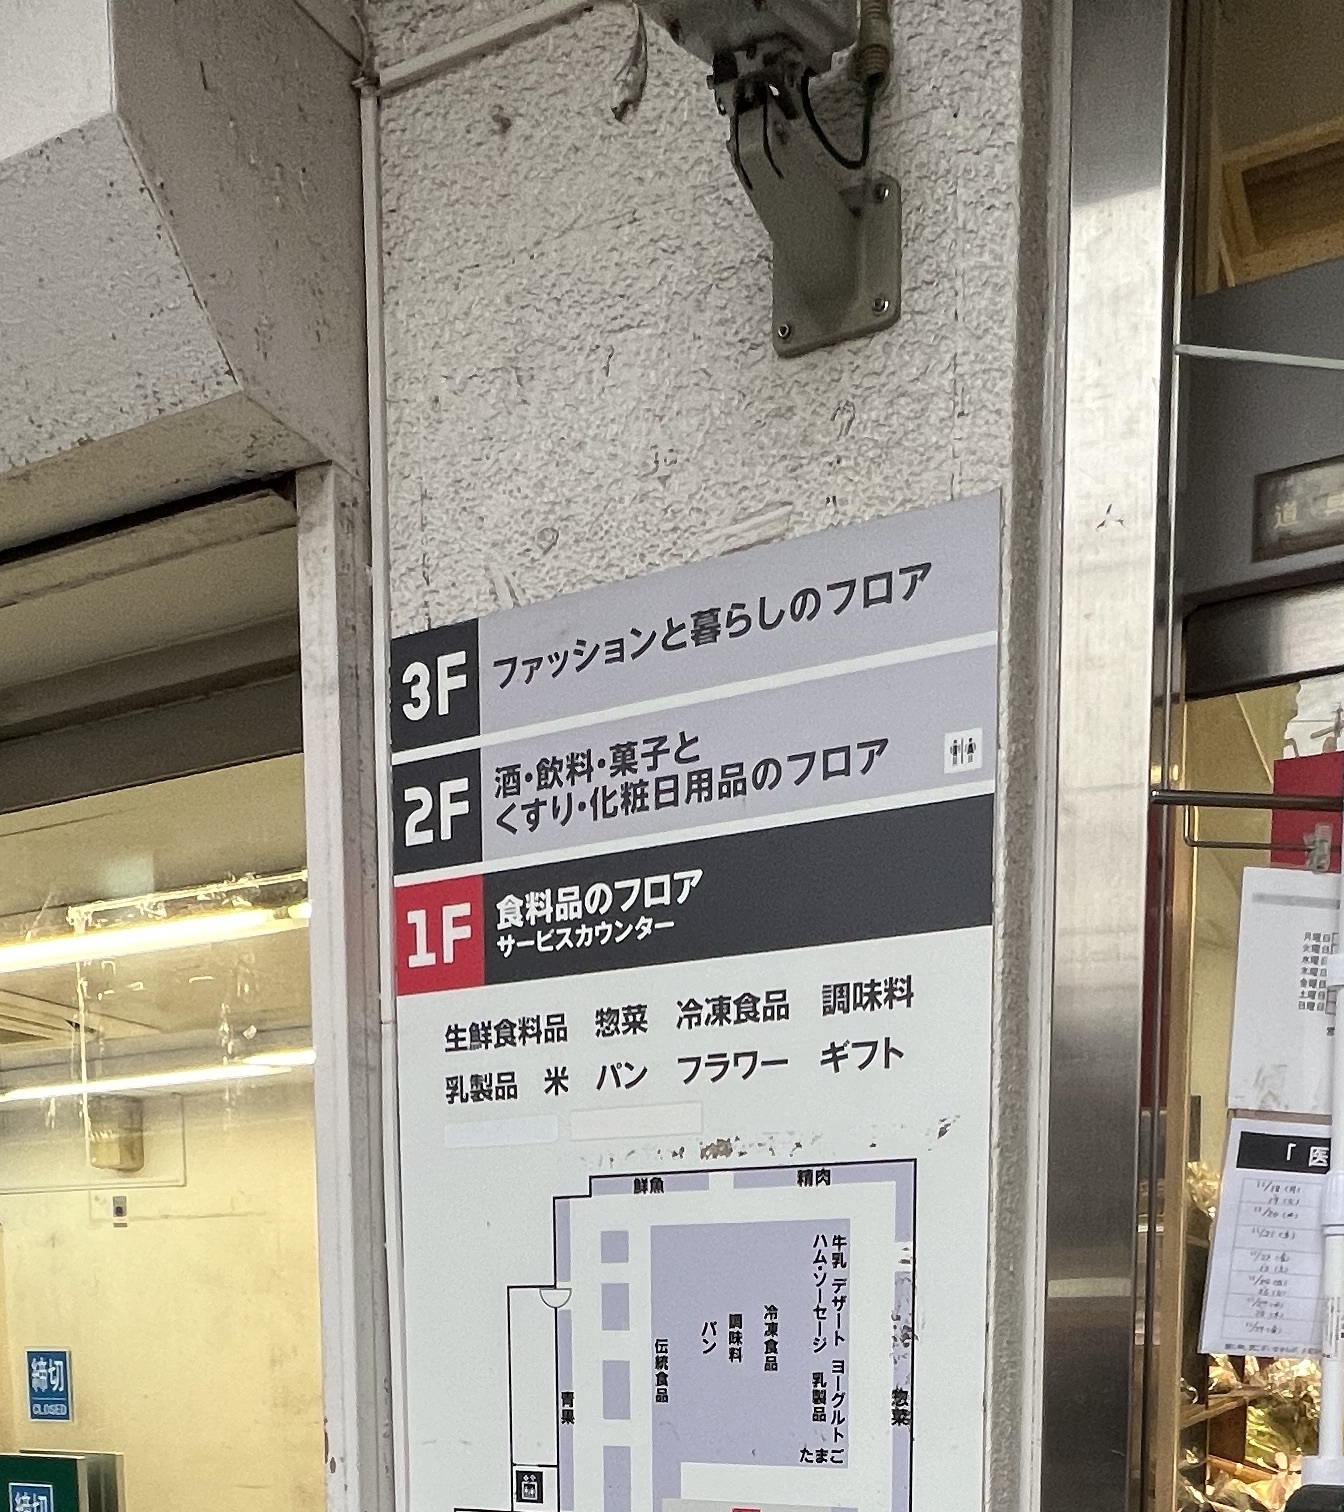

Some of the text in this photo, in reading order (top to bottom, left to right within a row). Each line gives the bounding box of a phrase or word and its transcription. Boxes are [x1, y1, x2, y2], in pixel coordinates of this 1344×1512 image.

[493, 562, 933, 690] ファッションと暮らしのフロア
[401, 650, 467, 723] 3F
[494, 731, 701, 800] 酒・飲料・菓子と
[495, 737, 889, 838] くすり・化粧日用品のフロア
[403, 777, 471, 848] 2F
[495, 868, 704, 932] 食料品のフロア
[406, 903, 473, 969] 1F
[496, 918, 676, 959] サービスカウンター
[444, 975, 914, 1054] 生鮮食料品 惣菜 冷凍食品 調味料
[444, 1036, 905, 1105] 乳製品 米 パン フラワー ギフト
[633, 1168, 832, 1195] 鮮魚 精肉
[701, 1320, 718, 1355] パン
[763, 1304, 779, 1372] 冷凍食品
[812, 1233, 828, 1423] ハム・ソーセージ 乳製品
[830, 1234, 848, 1443] 牛乳 デザート ヨーグルト
[654, 1338, 669, 1404] 伝統食品
[32, 1403, 67, 1416] CLOSED
[799, 1446, 845, 1465] たまご
